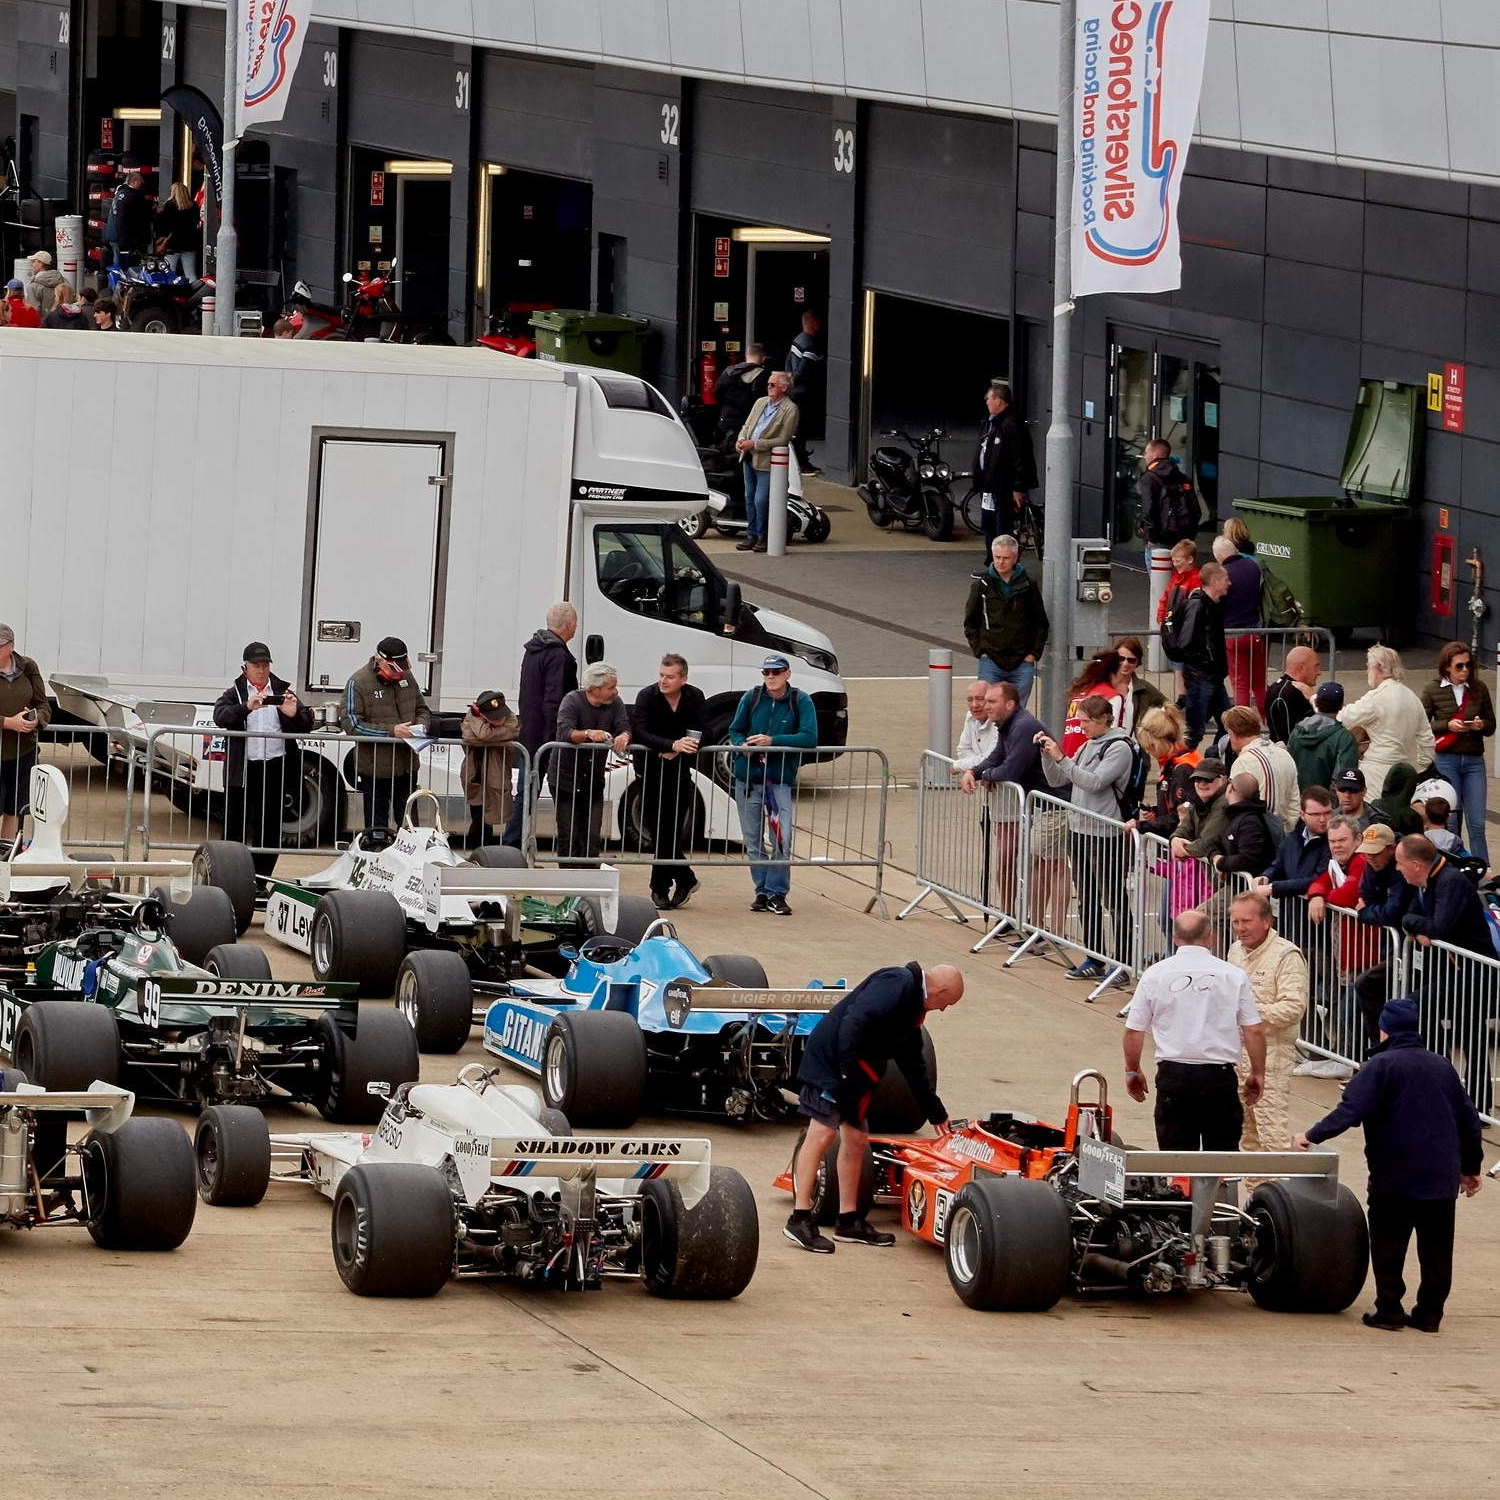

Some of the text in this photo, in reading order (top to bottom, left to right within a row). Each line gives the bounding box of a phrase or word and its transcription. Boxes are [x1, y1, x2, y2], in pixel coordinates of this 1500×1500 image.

[58, 11, 70, 44] 28
[162, 25, 175, 60] 29
[323, 51, 337, 87] 30
[455, 70, 469, 109] 31
[660, 103, 679, 146] 32
[833, 128, 854, 174] 33
[1450, 368, 1458, 385] H
[588, 487, 625, 495] PARTNER
[1256, 542, 1291, 557] GRUNDON
[36, 775, 46, 815] 22
[393, 838, 417, 856] Mobil
[367, 861, 396, 883] Techniques
[277, 900, 290, 933] 37
[193, 980, 300, 997] DENIM
[731, 993, 841, 1005] LIGIER GITANES
[142, 980, 161, 1029] 99
[670, 1010, 680, 1025] elf
[514, 1140, 682, 1157] SHADOW CARS
